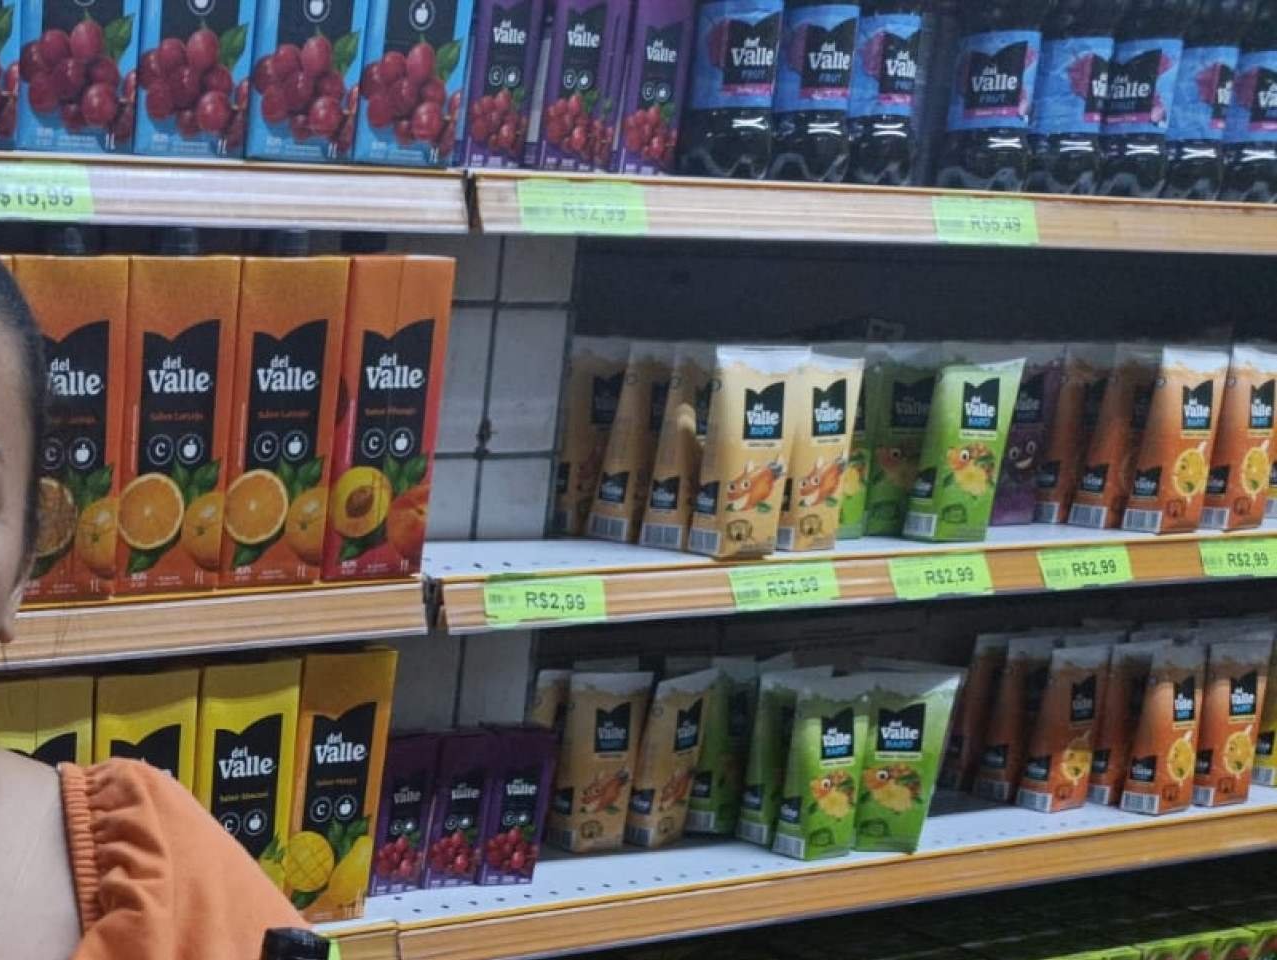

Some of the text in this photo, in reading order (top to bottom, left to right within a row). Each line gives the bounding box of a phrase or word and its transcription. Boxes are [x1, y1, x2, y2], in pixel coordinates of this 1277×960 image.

[493, 27, 526, 45] Valle
[567, 30, 599, 48] Valle
[646, 45, 677, 62] Valle
[731, 46, 774, 66] Valle
[808, 50, 851, 70] Valle
[886, 58, 916, 78] Vall
[971, 73, 1018, 92] Valle
[162, 355, 182, 370] del
[270, 354, 290, 369] del
[379, 353, 398, 367] del
[49, 369, 103, 397] alle
[148, 366, 211, 394] Valle
[257, 365, 318, 392] Valle
[365, 362, 424, 390] Valle
[1071, 559, 1117, 577] R$2,99
[1227, 551, 1269, 570] R$2,99
[924, 566, 974, 587] R$2,99
[766, 577, 819, 599] R$2,99
[524, 590, 586, 613] R$2,99
[314, 741, 367, 765] Valle
[219, 756, 275, 780] Valle
